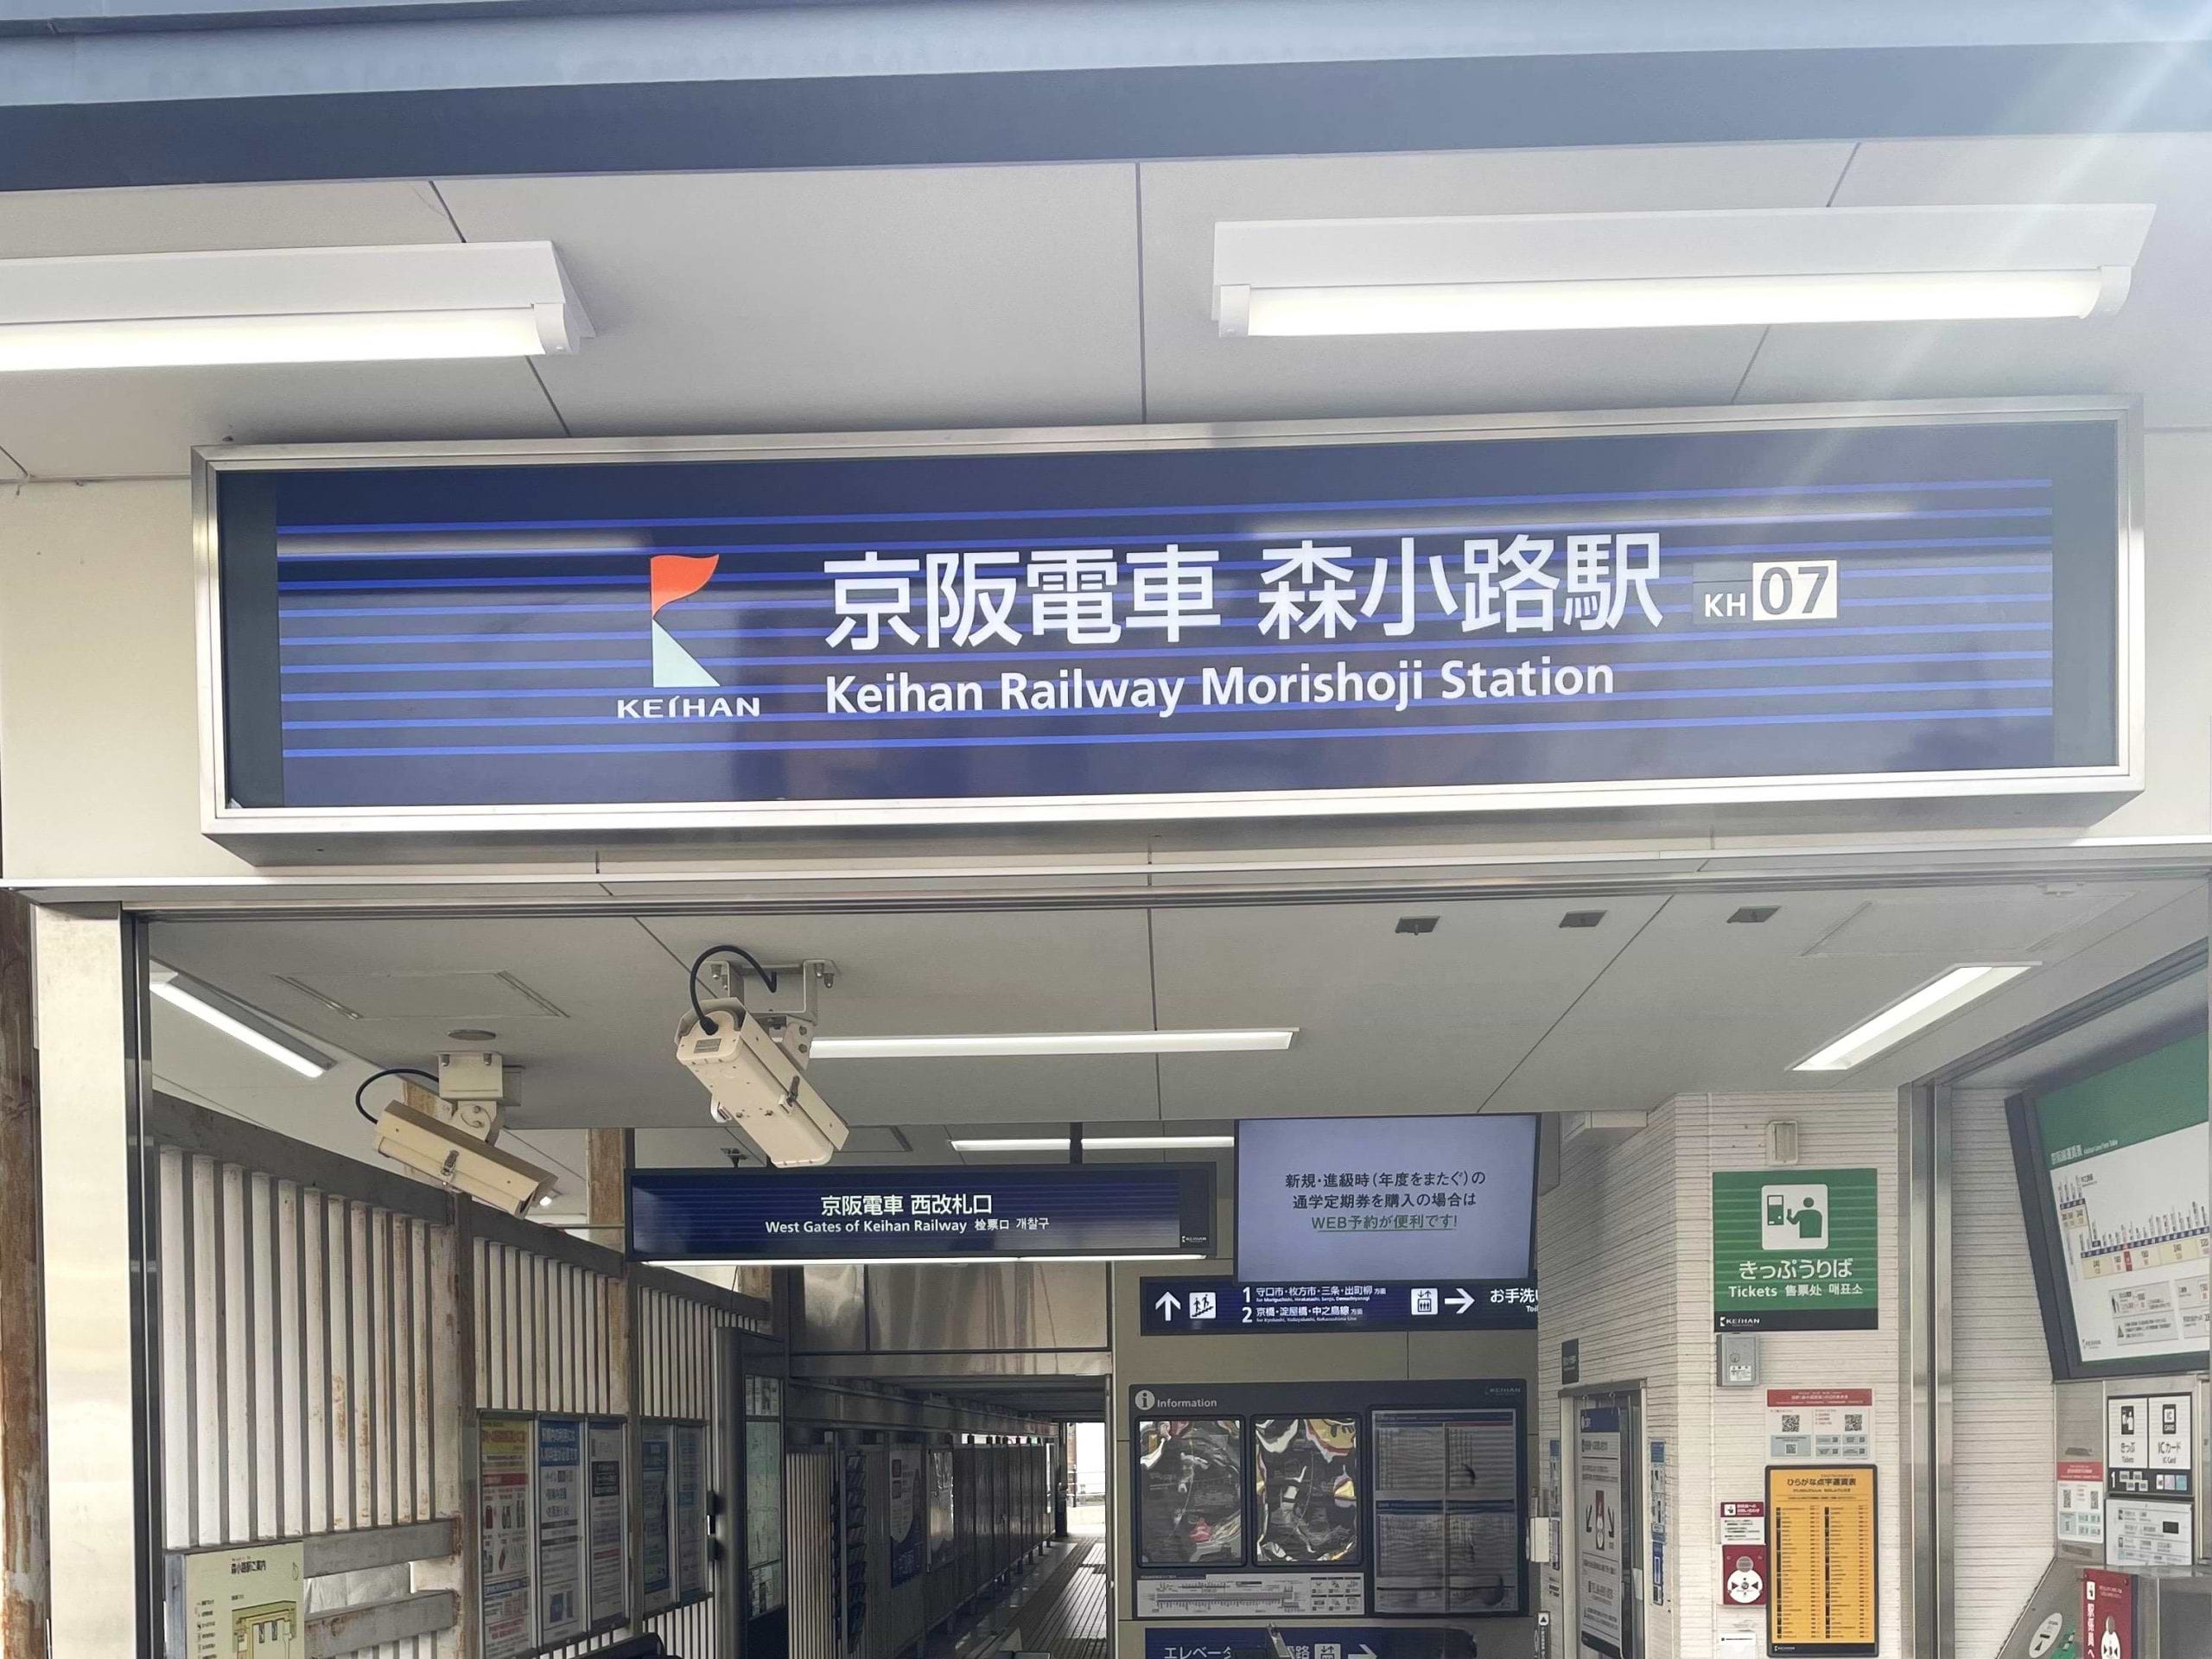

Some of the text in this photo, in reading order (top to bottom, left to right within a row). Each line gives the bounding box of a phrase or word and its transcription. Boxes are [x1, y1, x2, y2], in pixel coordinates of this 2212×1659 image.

[823, 532, 1663, 650] 京阪電車 森小路駅
[1705, 565, 1830, 618] KH 07
[826, 656, 1614, 718] Keihan Railway Morishoji Station
[617, 696, 760, 719] KEIHAN
[820, 1194, 993, 1217] 京阪電車 西改札口
[1293, 1192, 1477, 1210] 通学定期券を購入の場合は
[766, 1221, 800, 1233] West
[804, 1220, 842, 1233] Gates
[845, 1219, 861, 1232] of
[864, 1219, 910, 1233] Keihan
[914, 1218, 968, 1234] Railway
[1738, 1257, 1853, 1281] きっぷうりば
[1243, 1287, 1251, 1303] 1
[1728, 1285, 1778, 1298] Tickets
[1242, 1306, 1253, 1324] 2
[1157, 1397, 1217, 1408] Information
